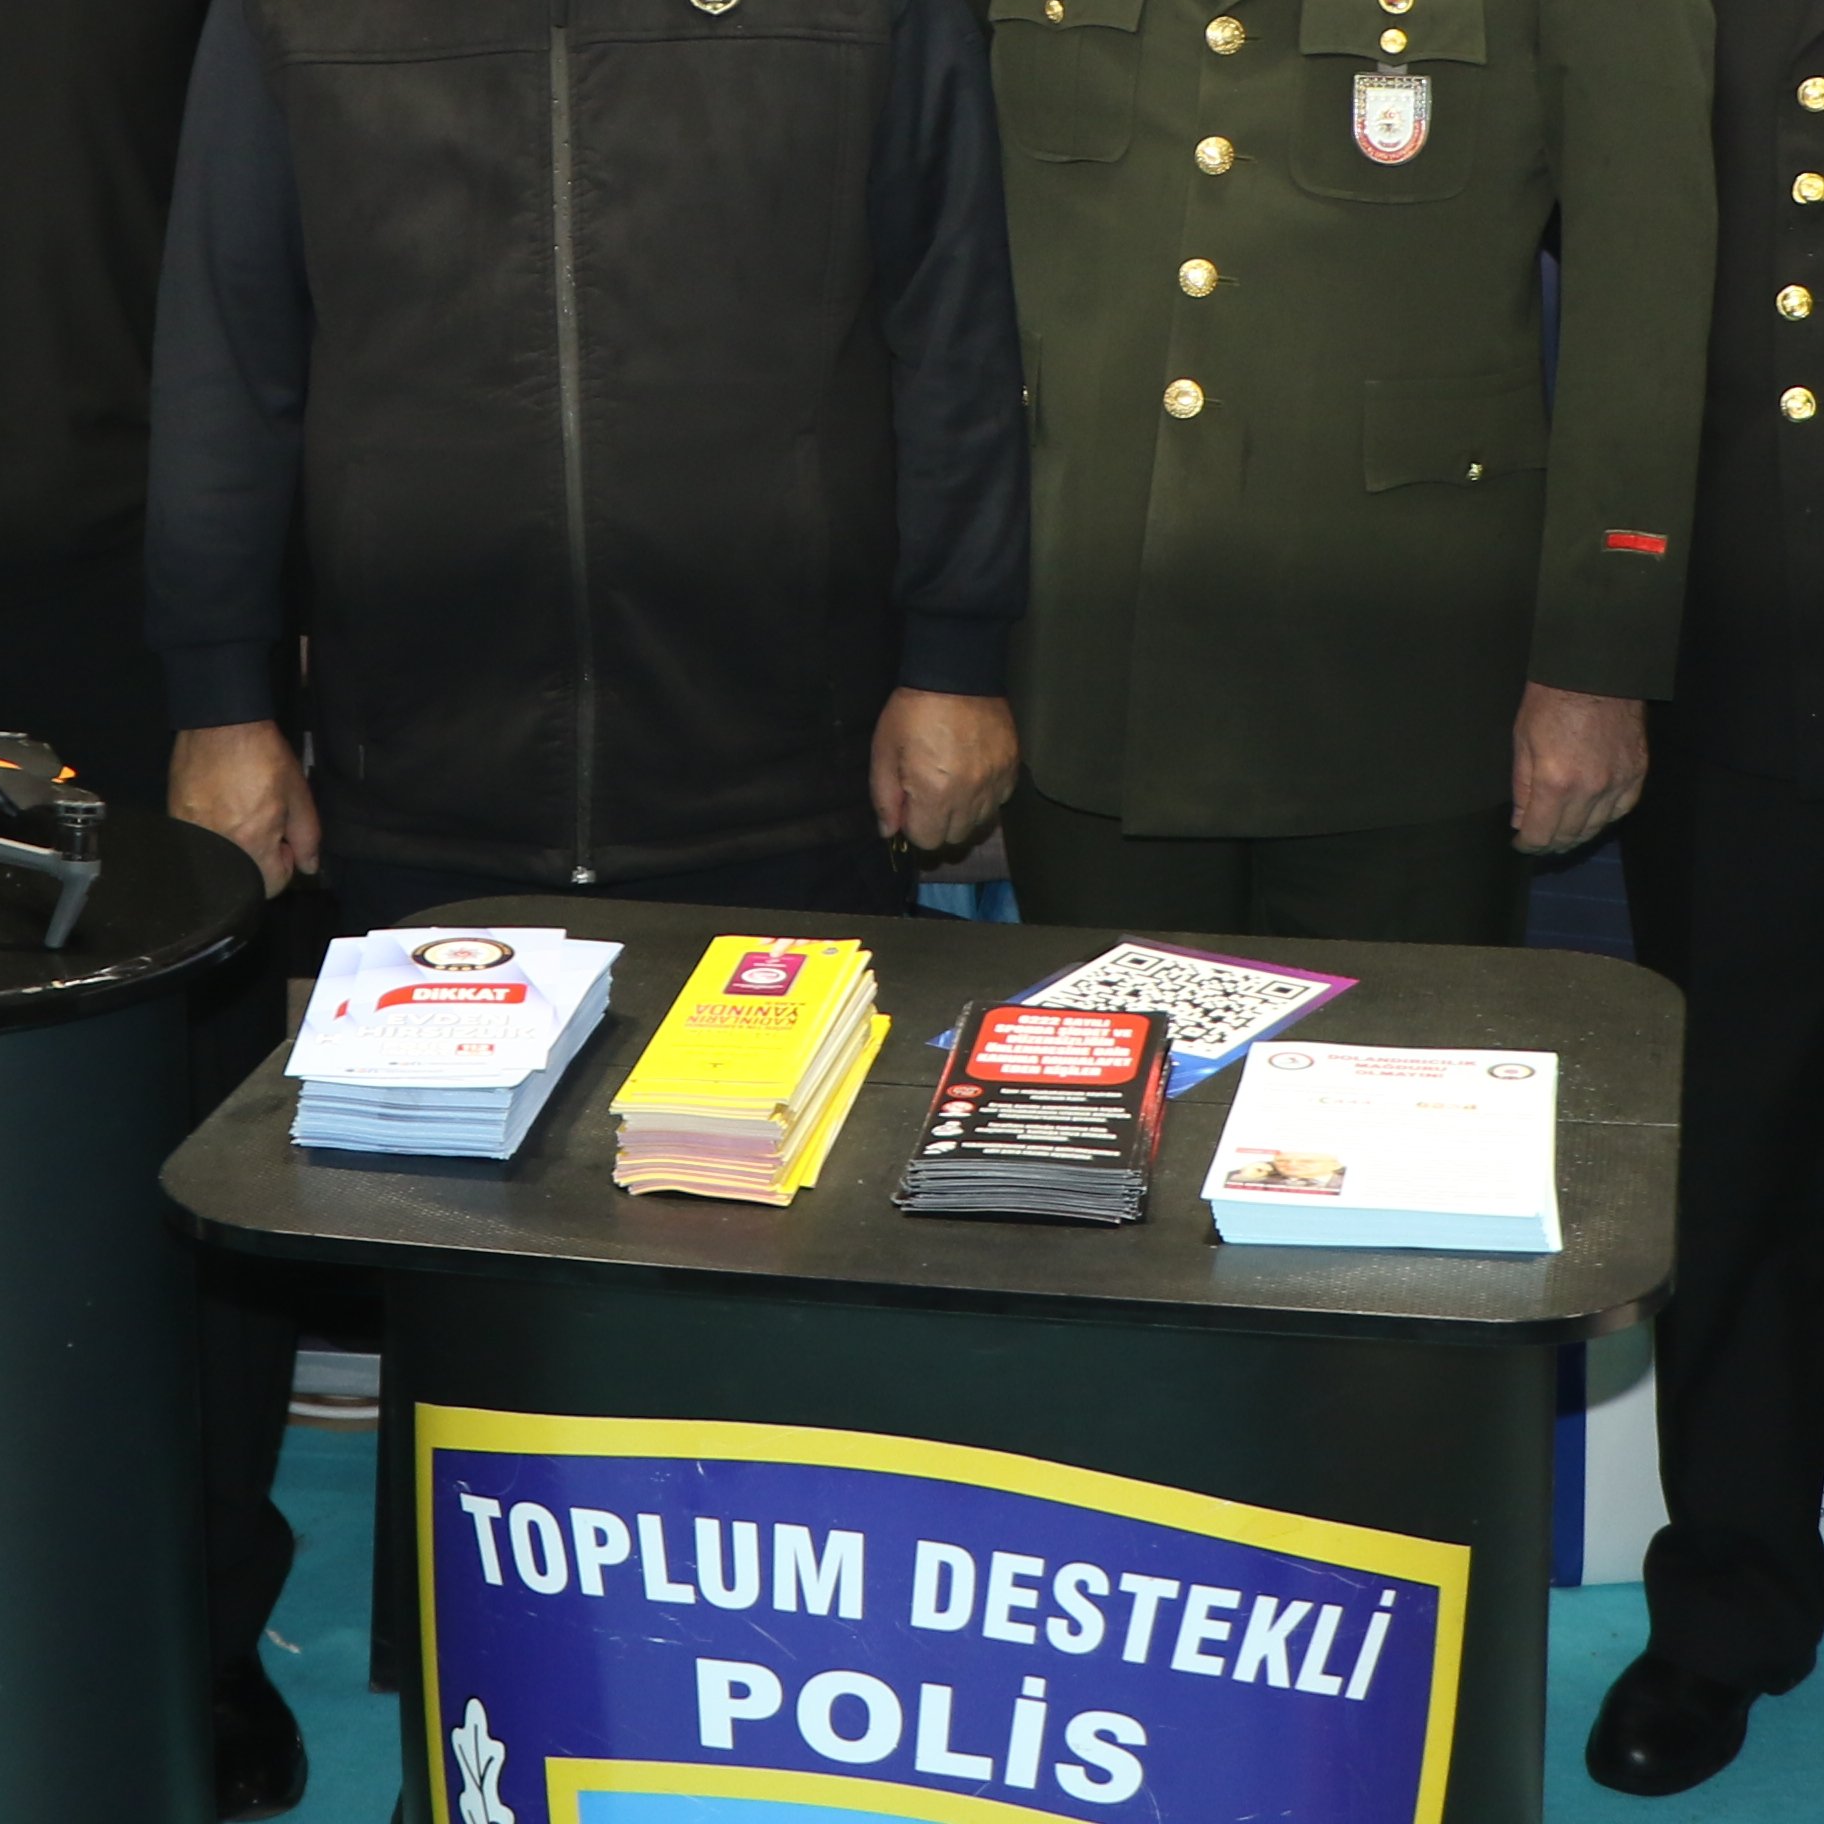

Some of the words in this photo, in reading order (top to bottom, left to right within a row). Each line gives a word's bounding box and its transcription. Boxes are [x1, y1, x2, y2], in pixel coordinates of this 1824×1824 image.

[411, 985, 511, 1002] DİKKAT
[459, 1492, 865, 1621] TOPLUM
[909, 1537, 1395, 1702] DESTEKLİ
[693, 1656, 1149, 1806] POLİS
